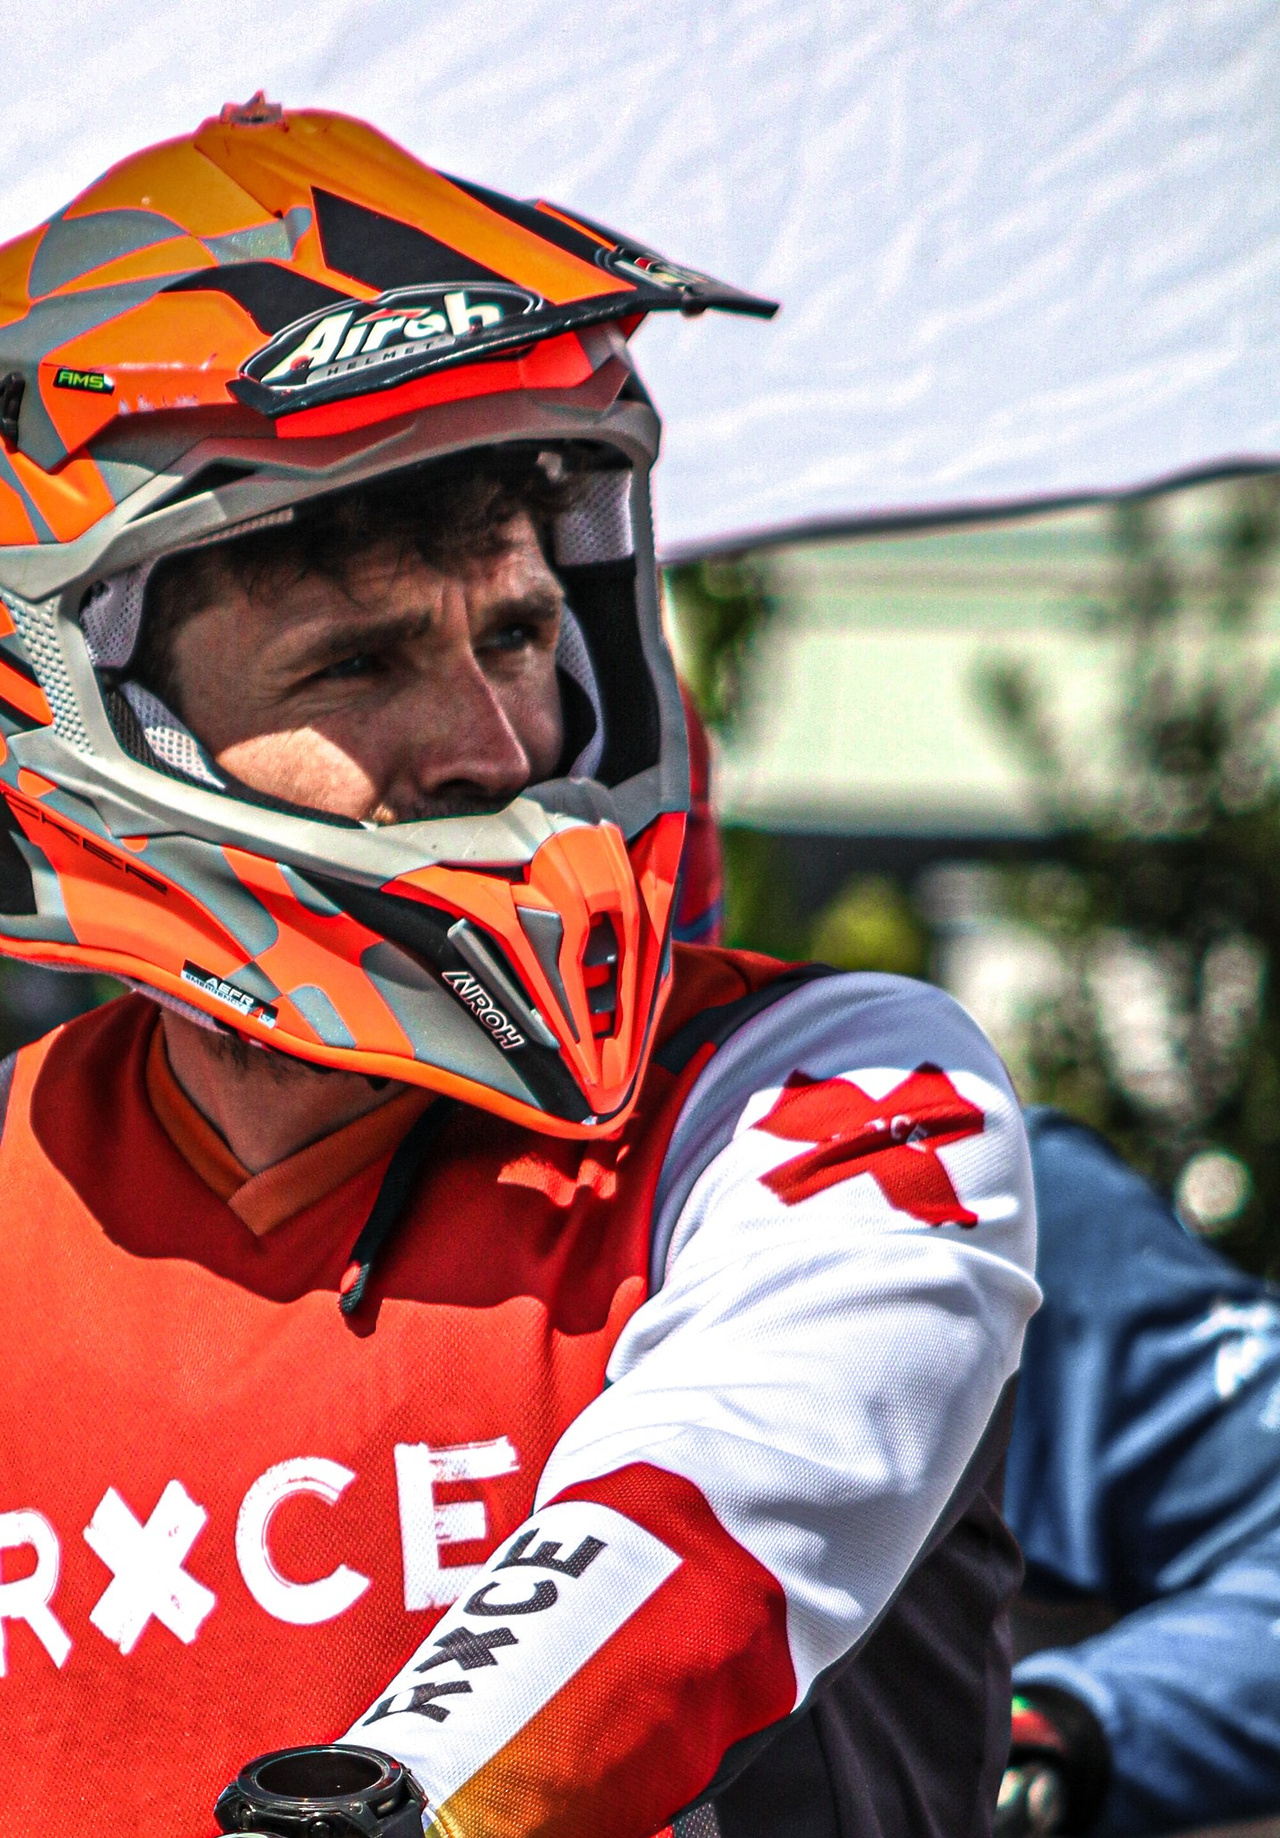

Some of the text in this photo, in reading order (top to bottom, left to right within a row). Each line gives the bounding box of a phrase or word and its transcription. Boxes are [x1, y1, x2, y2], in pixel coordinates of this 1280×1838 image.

[260, 291, 504, 384] Airoh
[326, 340, 436, 377] HELMET
[57, 370, 104, 390] AMS
